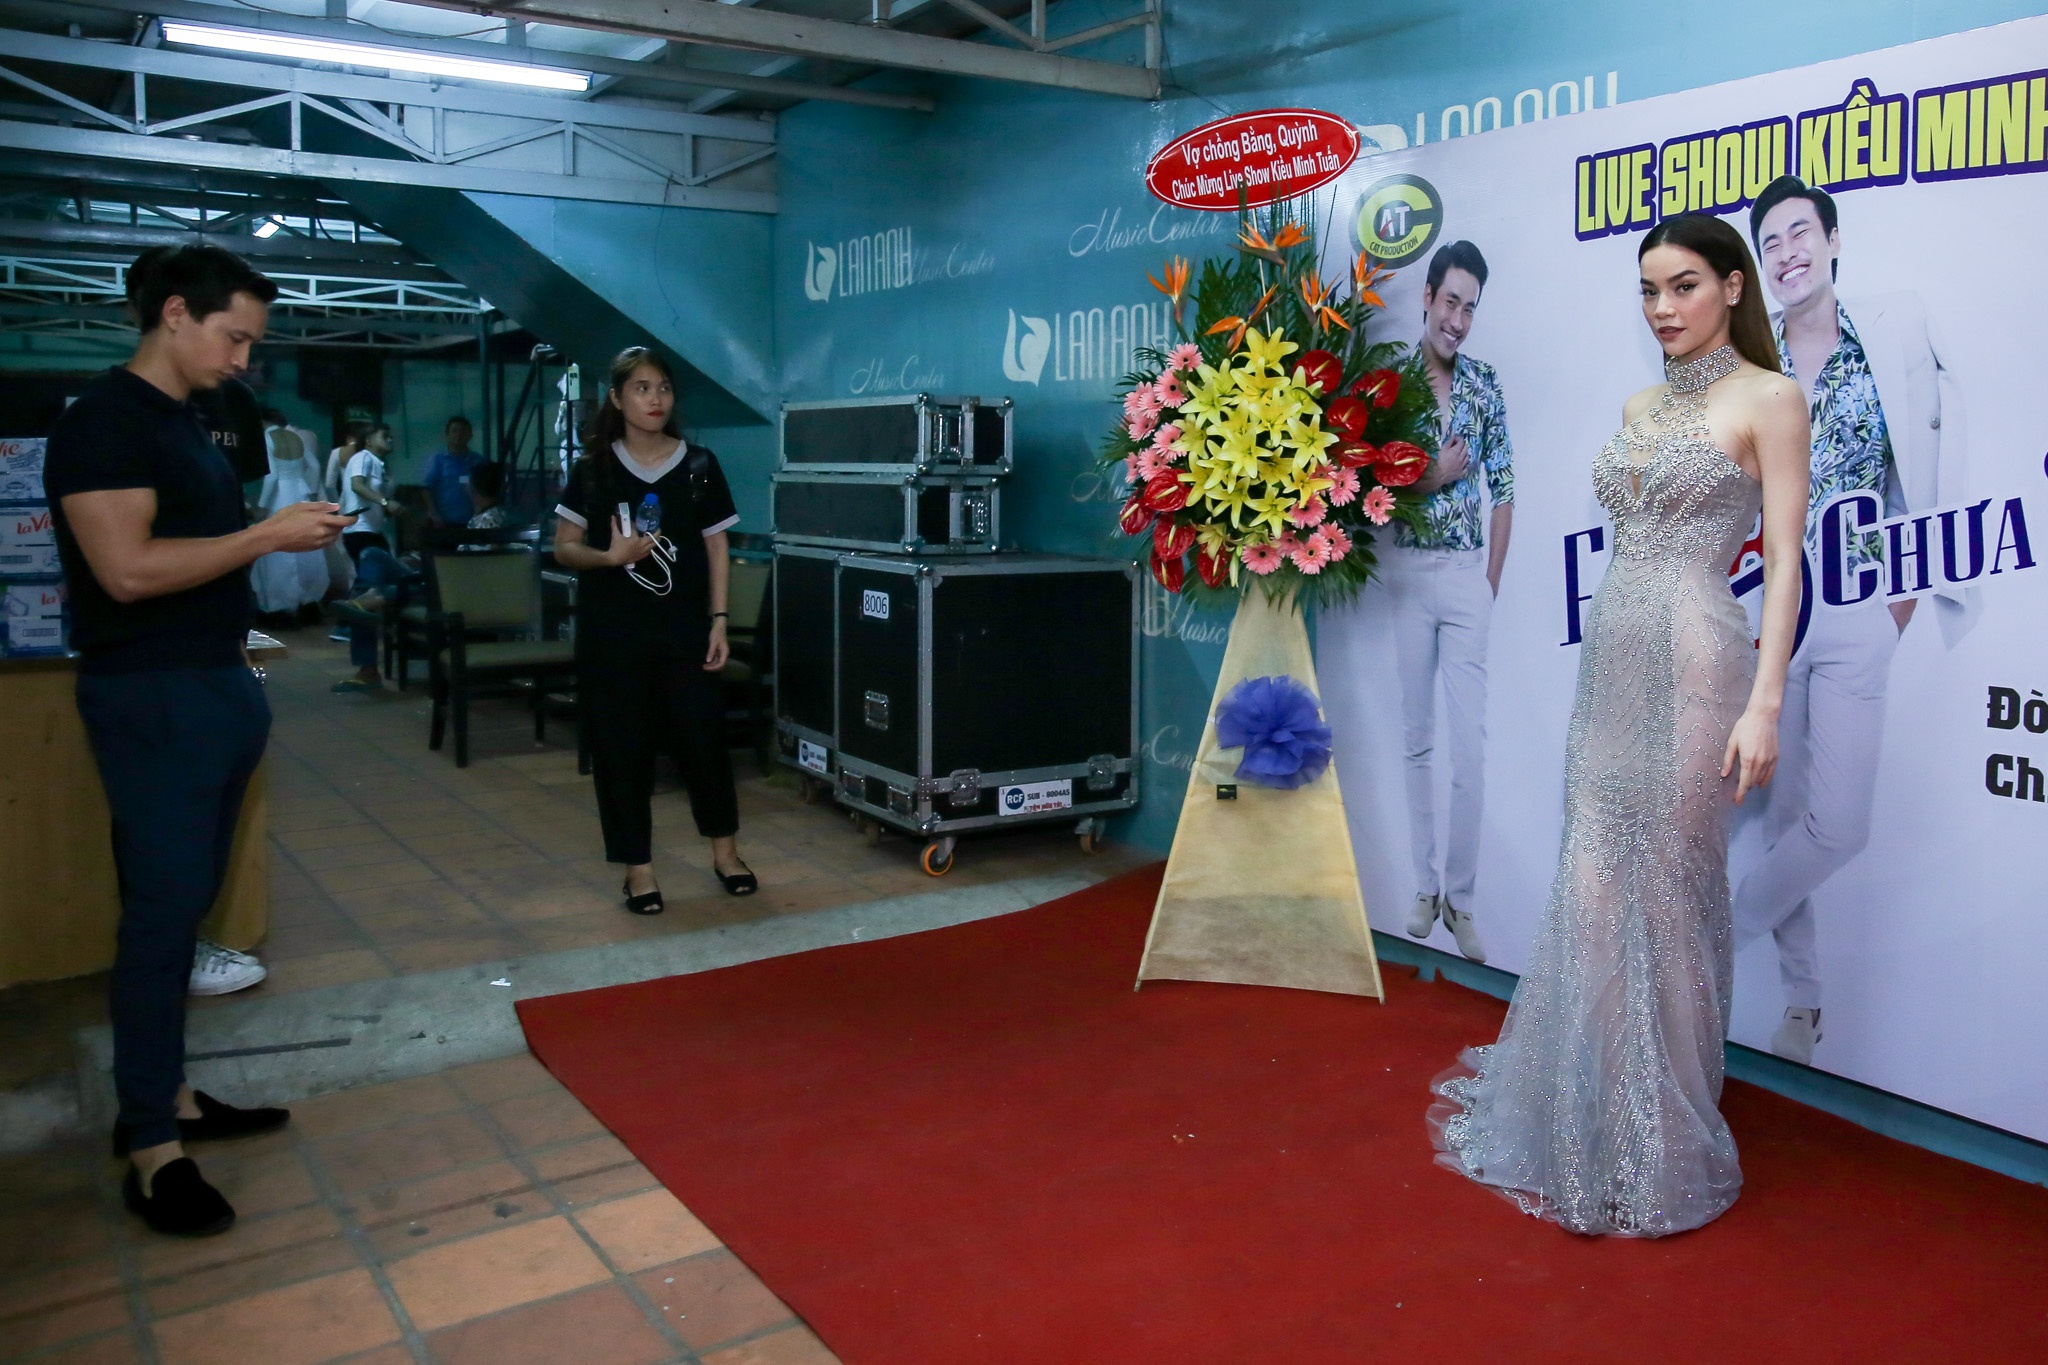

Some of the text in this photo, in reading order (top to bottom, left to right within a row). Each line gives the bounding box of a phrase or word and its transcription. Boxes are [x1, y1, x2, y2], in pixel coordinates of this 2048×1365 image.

[1181, 119, 1319, 169] Vợ chồng Bằng, Quỳnh
[1577, 147, 1653, 236] LIVE
[1660, 119, 1789, 219] SHOW
[1798, 83, 1904, 189] KIỀU
[1171, 145, 1341, 201] Chúc Mừng Live Show Kiều Minh Tuấn
[1380, 236, 1419, 256] PRODUCTION
[864, 594, 888, 615] 8006
[1985, 752, 2048, 804] Ch
[1006, 793, 1024, 805] RCF
[1027, 792, 1040, 801] SUB
